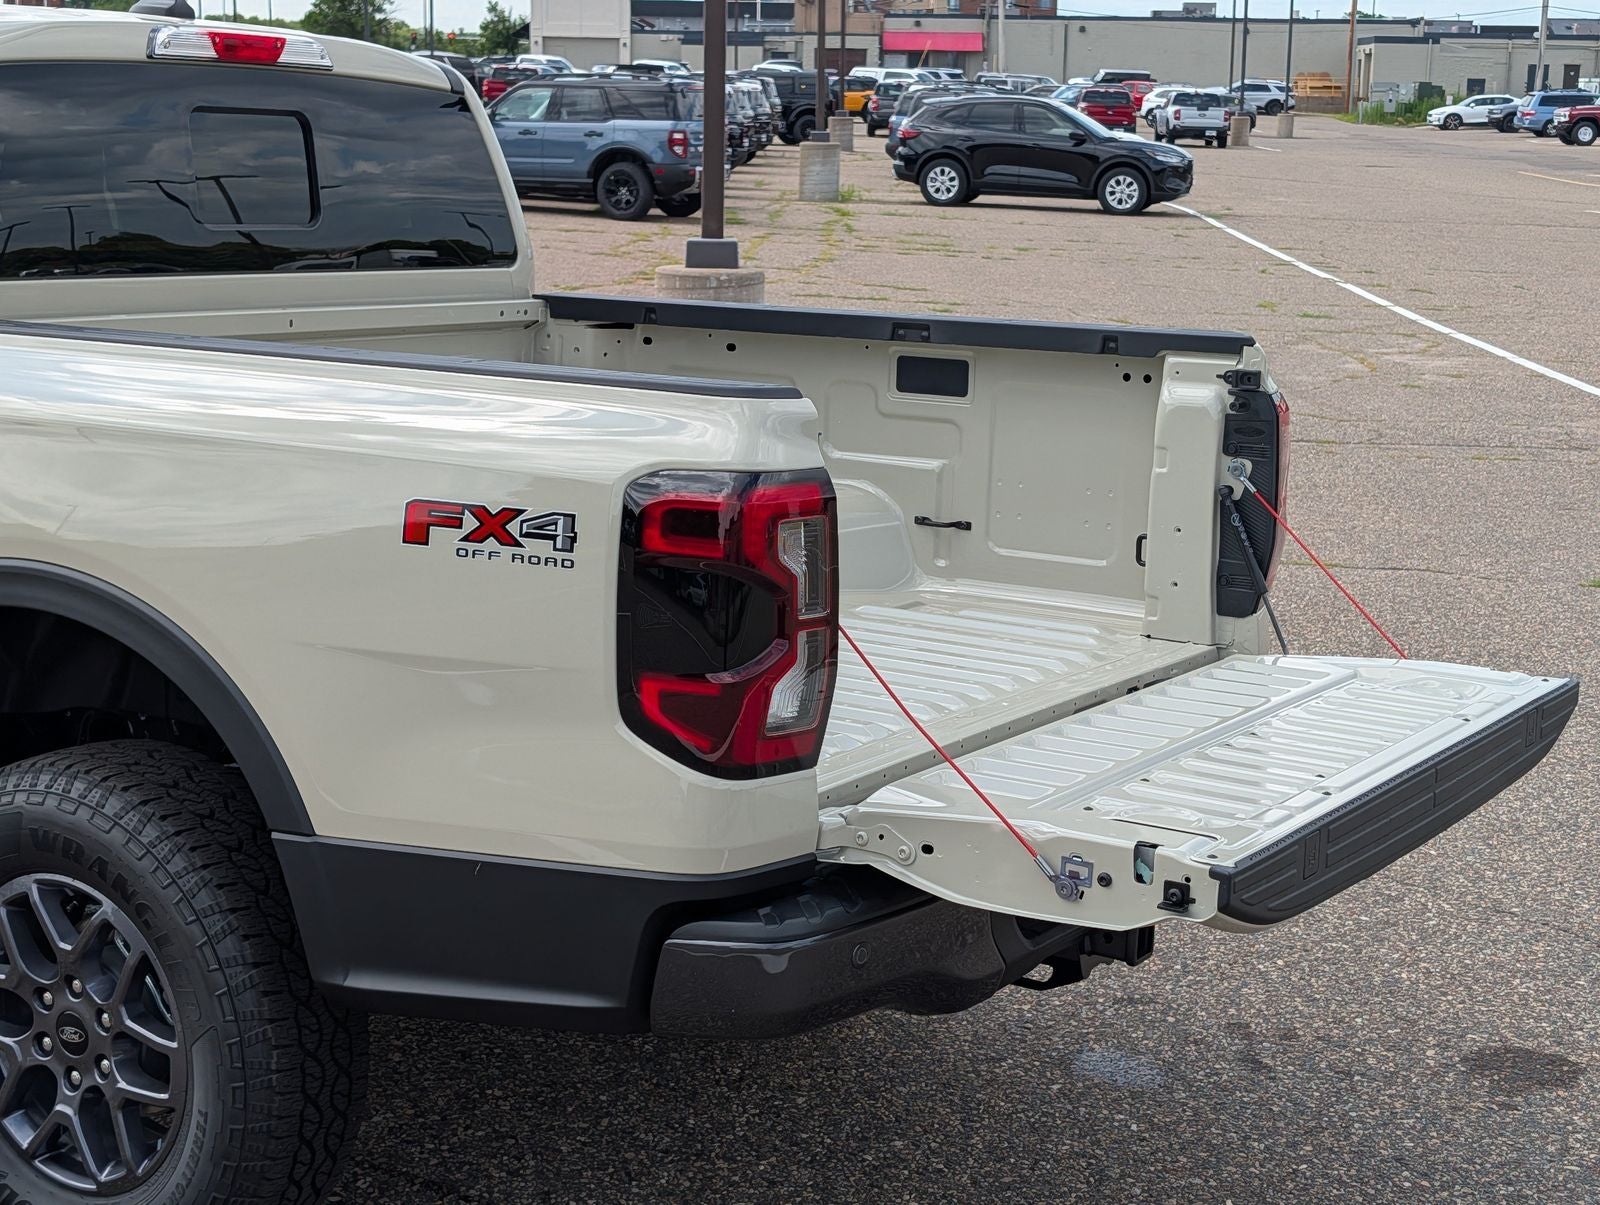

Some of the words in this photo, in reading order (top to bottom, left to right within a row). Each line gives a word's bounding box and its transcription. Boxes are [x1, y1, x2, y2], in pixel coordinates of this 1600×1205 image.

[401, 498, 577, 553] FX4
[456, 547, 502, 561] OFF
[511, 553, 575, 569] ROAD
[61, 1028, 81, 1041] Ford
